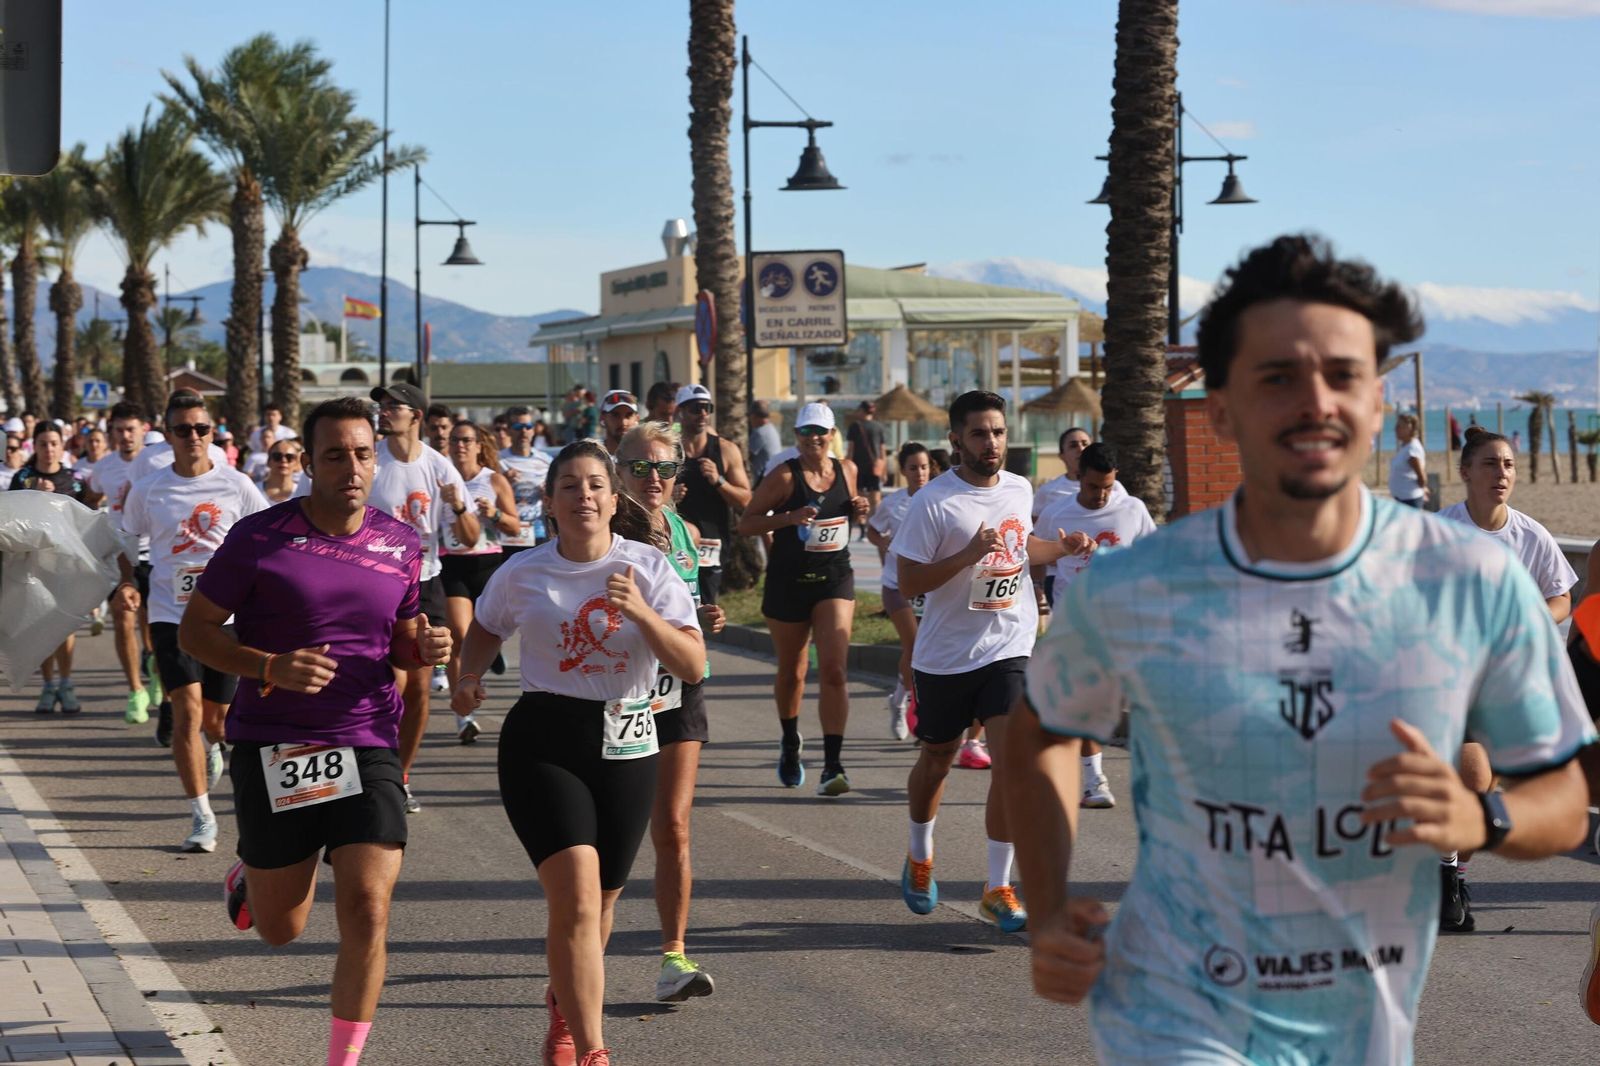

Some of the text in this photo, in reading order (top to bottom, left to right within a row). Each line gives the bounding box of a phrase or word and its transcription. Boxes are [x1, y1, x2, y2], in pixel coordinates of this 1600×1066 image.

[766, 316, 834, 328] EN CARRIL
[760, 328, 842, 341] SEÑALIZADO
[818, 527, 839, 542] 87
[985, 575, 1019, 598] 166
[618, 709, 652, 740] 758
[280, 750, 344, 789] 348
[1316, 805, 1396, 858] LOL
[1255, 951, 1334, 977] VIAJES
